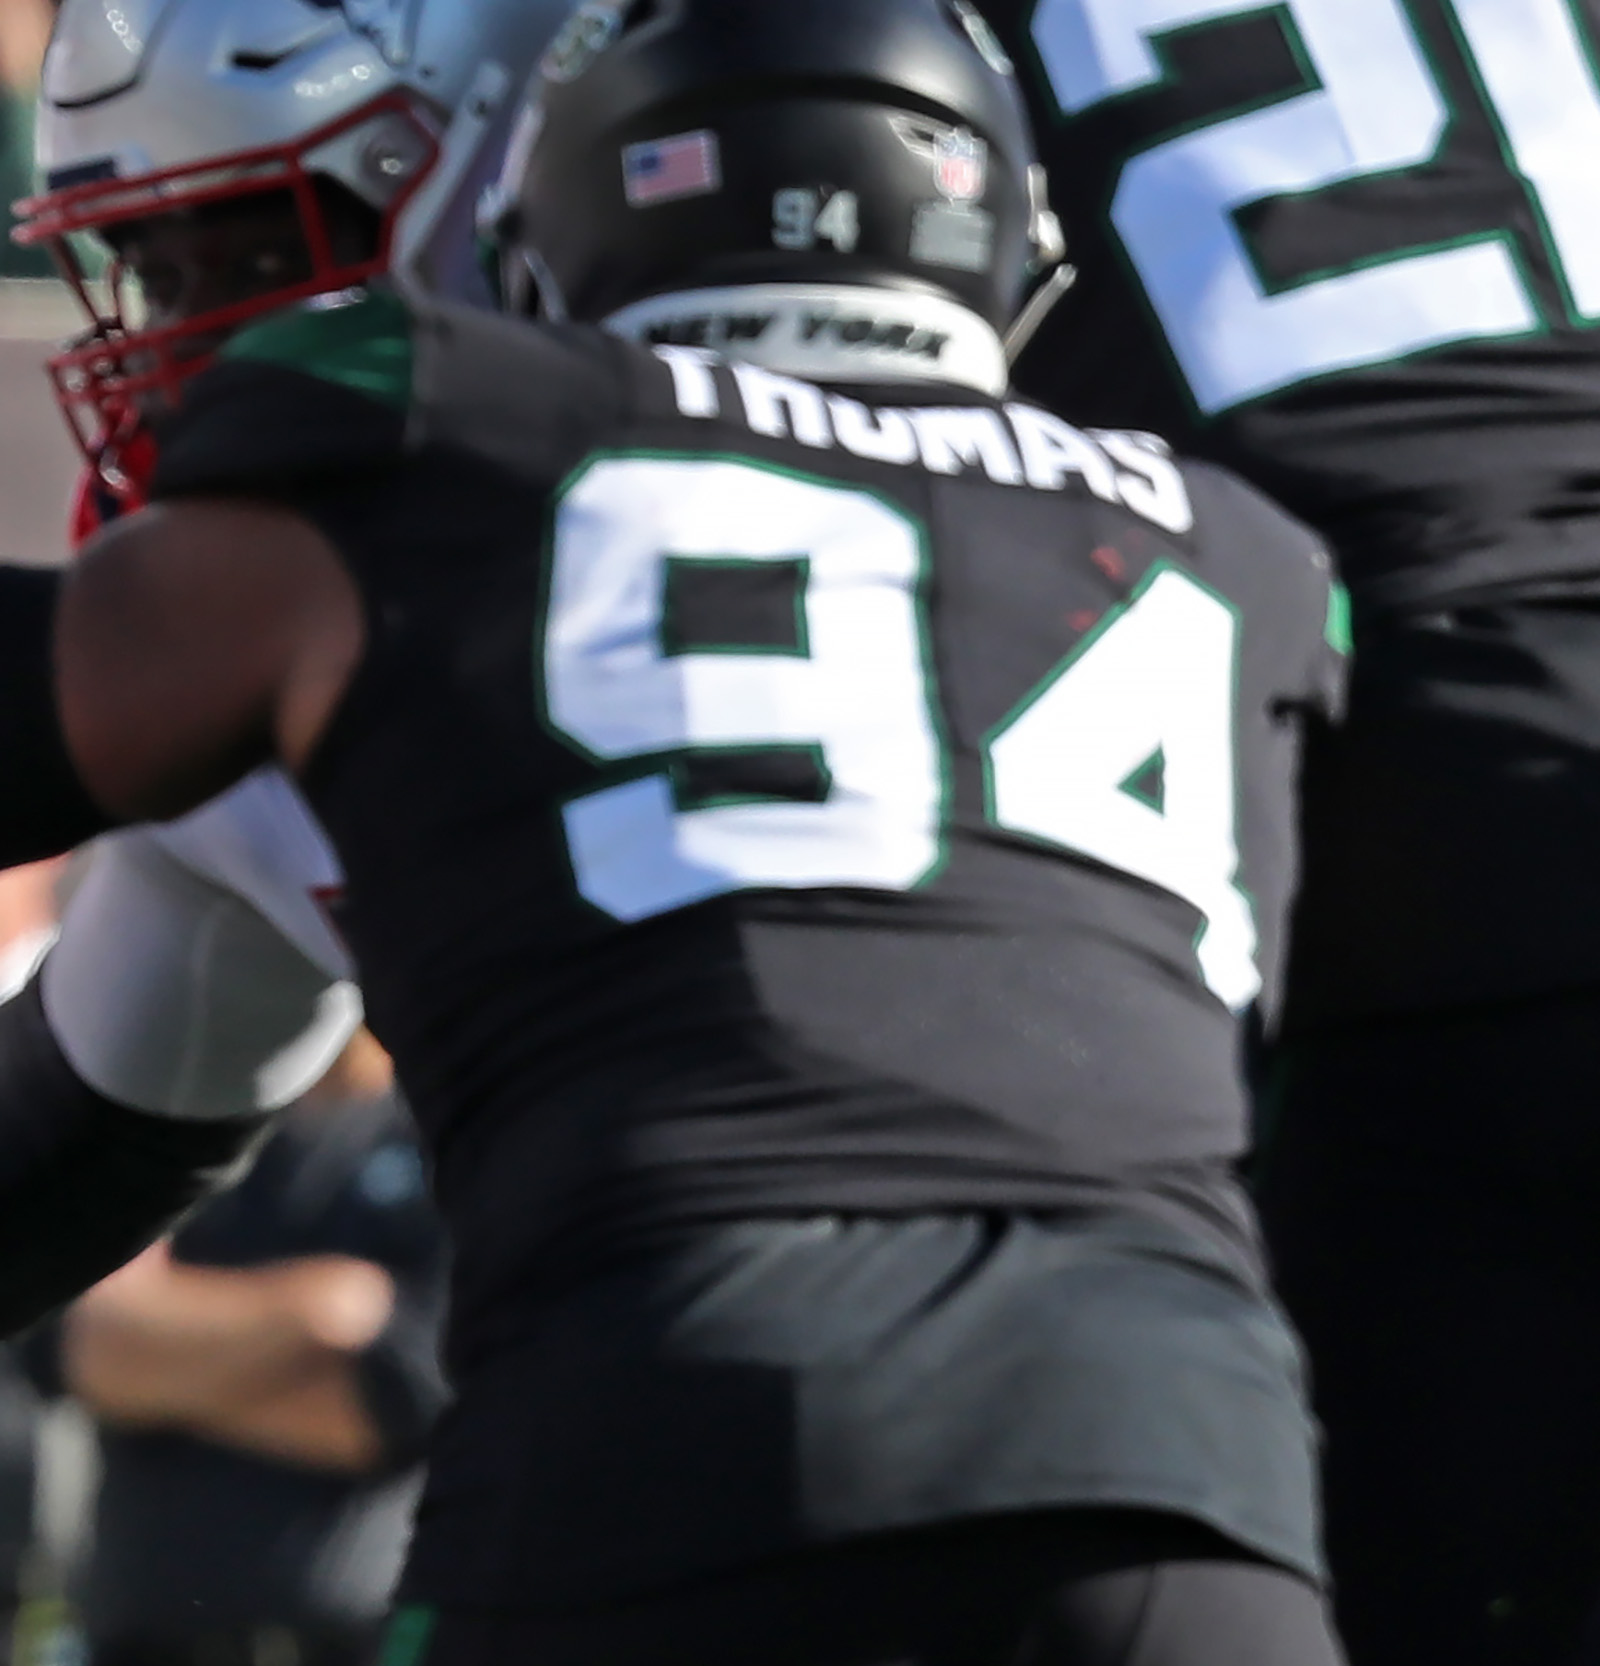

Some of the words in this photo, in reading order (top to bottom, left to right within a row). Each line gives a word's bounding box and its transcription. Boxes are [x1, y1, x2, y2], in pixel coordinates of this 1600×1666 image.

[770, 186, 860, 254] 94
[646, 312, 776, 346] NEW
[798, 314, 950, 362] YORK
[652, 342, 1194, 534] THOMAS
[540, 455, 1264, 1012] 94
